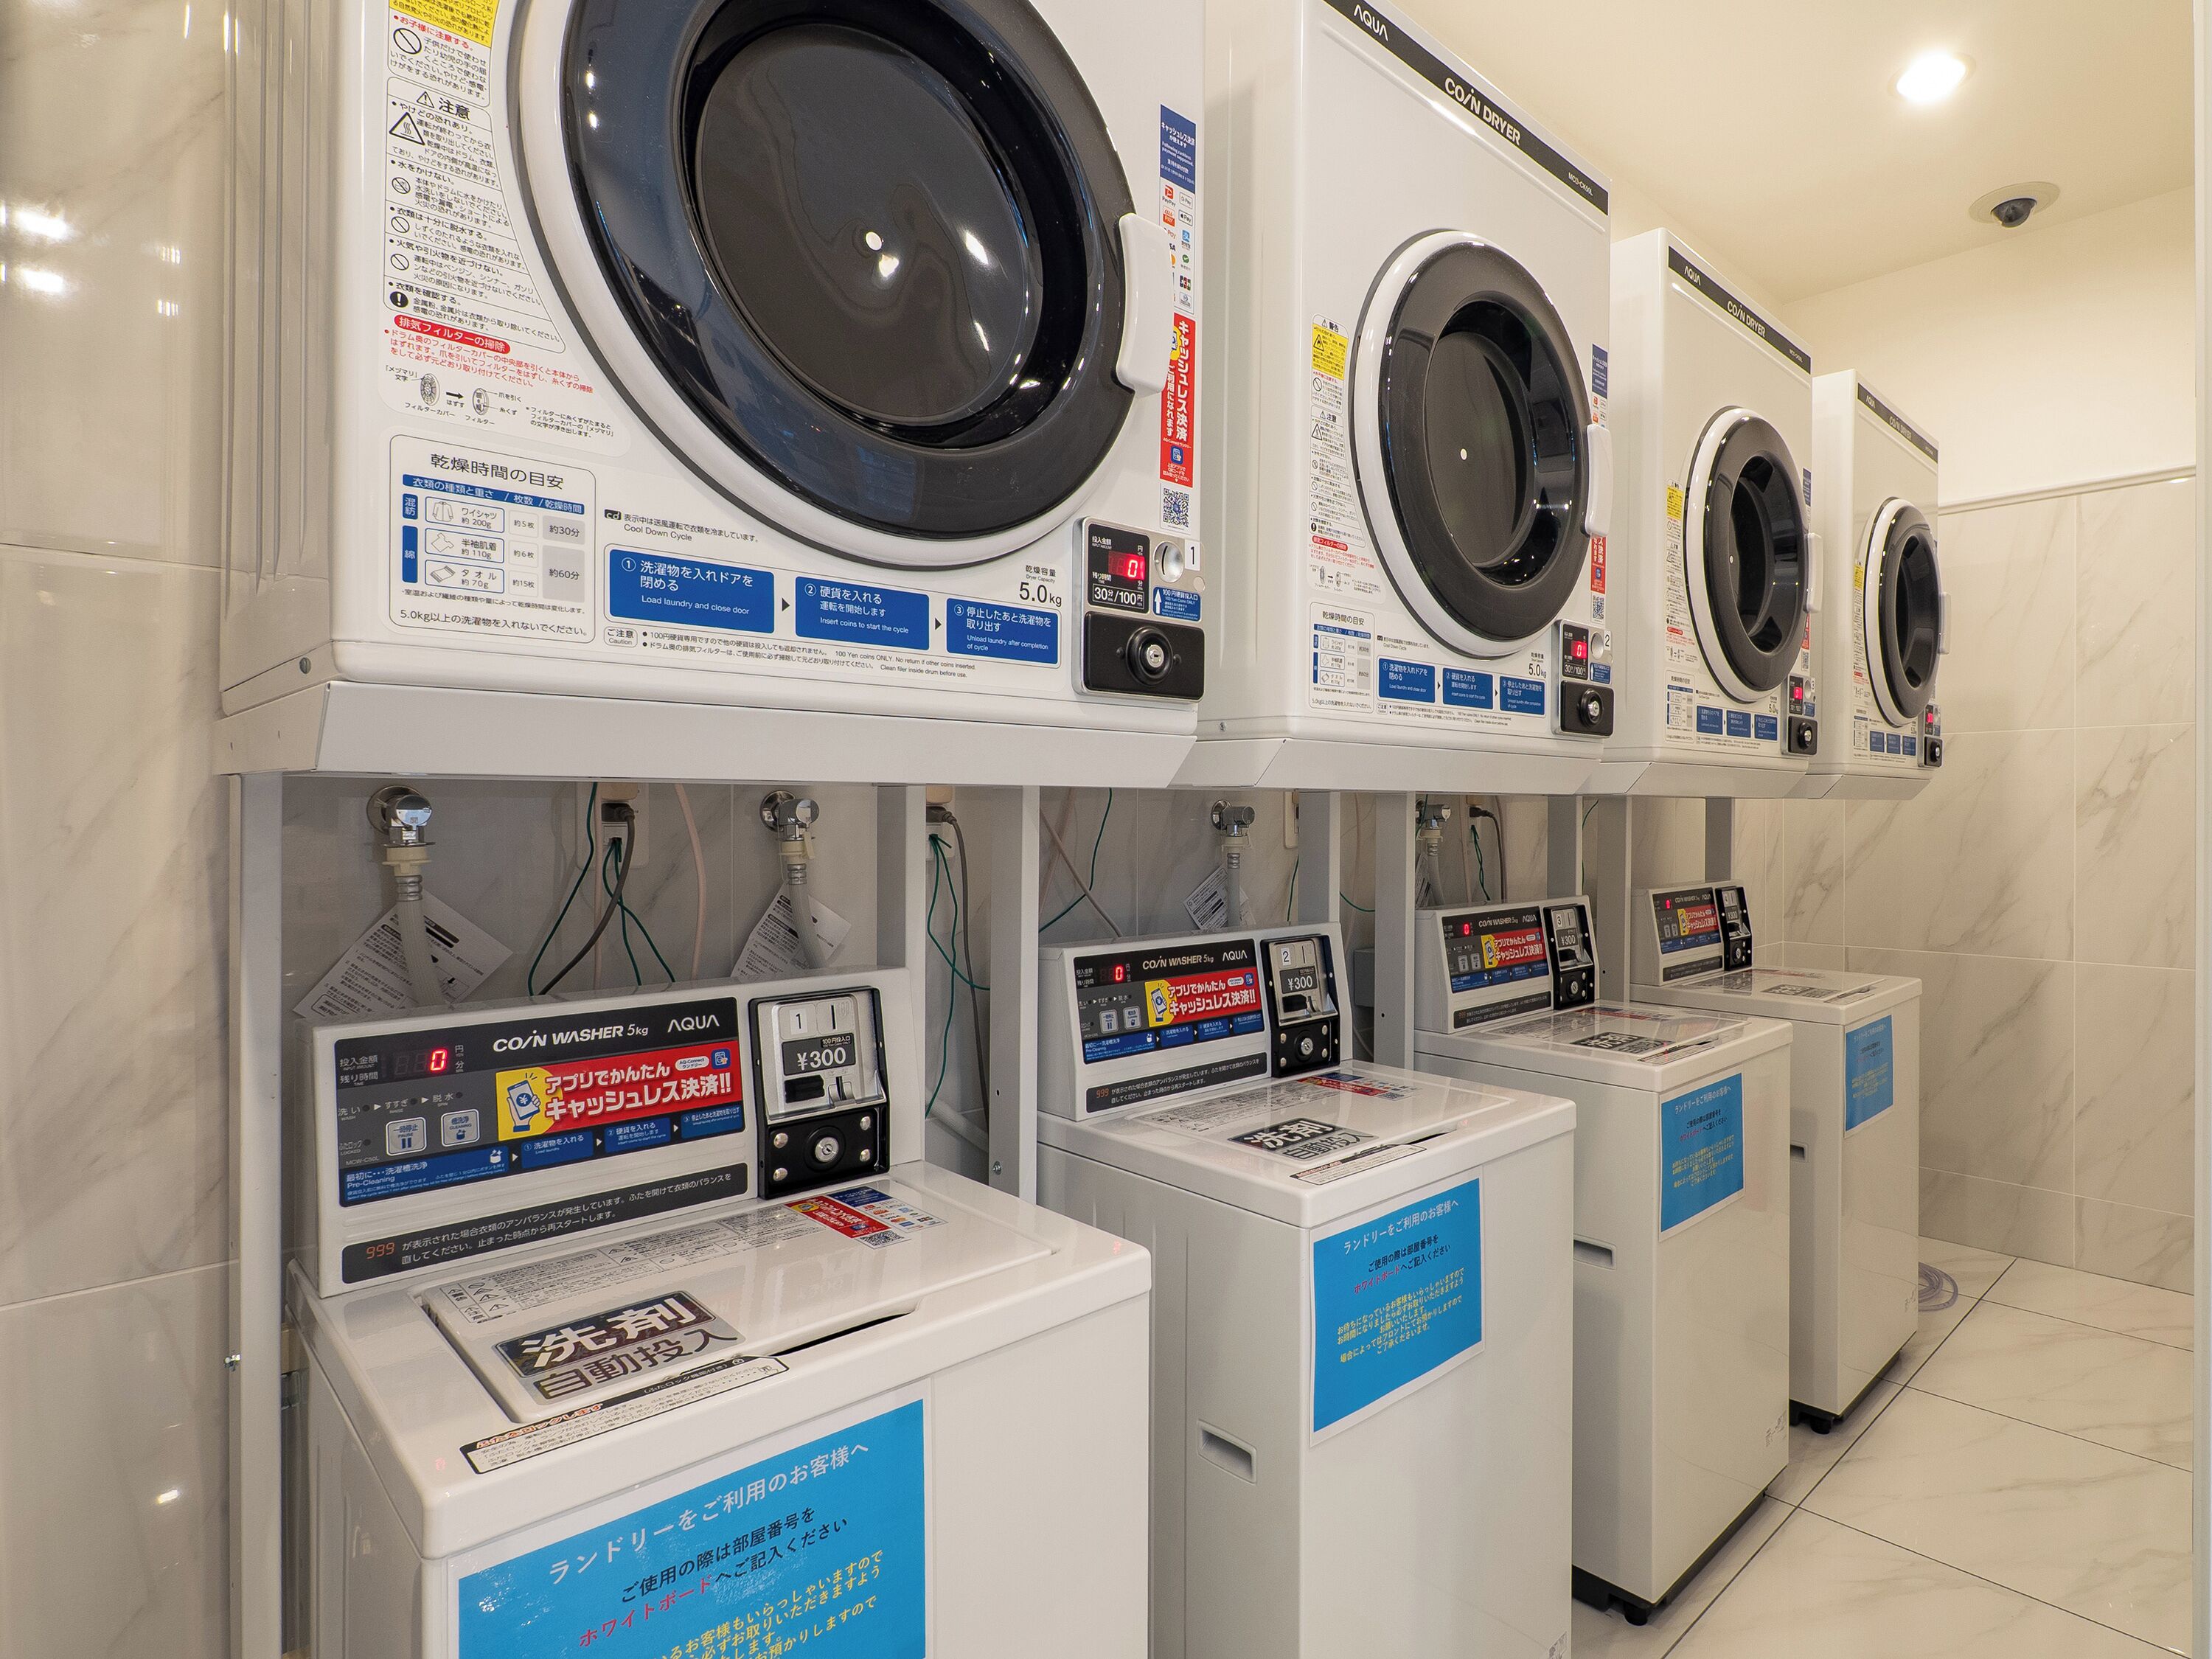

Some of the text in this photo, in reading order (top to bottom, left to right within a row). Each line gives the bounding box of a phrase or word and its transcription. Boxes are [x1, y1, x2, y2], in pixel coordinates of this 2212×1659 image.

[1354, 4, 1388, 41] AQUA
[400, 16, 473, 51] お子様に注意する。
[400, 102, 472, 134] やけどの恐れあり。
[439, 97, 470, 120] 注意
[1483, 105, 1521, 146] DRYER
[397, 161, 454, 184] 水をかけない。
[397, 206, 487, 240] 衣類は十分に脱水する。
[1684, 265, 1701, 285] AQUA
[396, 282, 462, 306] 衣類を確認する。
[398, 317, 507, 352] 排気フィルターの掃除
[1746, 317, 1766, 338] DRYER
[431, 453, 563, 490] 乾燥時間の目安
[624, 524, 692, 541] Cool Down Cycle
[640, 560, 754, 587] 洗濯物を入れドアを
[1025, 565, 1057, 577] 乾燥容量
[1128, 560, 1138, 578] 0
[640, 576, 679, 591] 閉める
[641, 595, 749, 614] Load laundry and close door
[820, 585, 883, 605] 硬貨を入れる
[820, 599, 886, 617] 運転を開始します
[967, 606, 1051, 627] 停止したあと洗濯物を
[1322, 611, 1364, 625] 乾燥時間の目安
[400, 609, 588, 636] 5.0kg以上の洗濯物を入れないでください。
[820, 617, 838, 625] Insert
[967, 618, 1002, 633] 取り出す
[607, 629, 634, 639] ご注意
[967, 635, 987, 643] Unload
[987, 637, 1007, 646] laundry
[1522, 914, 1537, 923] AQUA
[1561, 934, 1576, 946] ¥300
[1169, 955, 1203, 967] WASHER
[1222, 950, 1248, 962] AQUA
[1282, 950, 1290, 963] 2
[1116, 967, 1122, 981] 0
[1287, 975, 1313, 991] ¥300
[1168, 980, 1225, 998] アプリでかんたん
[667, 1015, 720, 1033] AQUA
[552, 1025, 624, 1045] WASHER
[627, 1024, 649, 1037] 5kg
[455, 1045, 464, 1053] 円
[797, 1047, 846, 1071] ¥300
[340, 1054, 378, 1065] 投入金額
[430, 1050, 446, 1071] 0
[455, 1060, 465, 1069] 分
[340, 1071, 378, 1084] 残り時間
[546, 1062, 670, 1093] アプリでかんたん
[385, 1099, 408, 1109] すすぎ
[546, 1072, 731, 1121] キャッシュレス決済!!
[616, 1122, 655, 1135] 硬貨を入れる
[1243, 1120, 1334, 1149] 洗剤
[534, 1134, 585, 1150] 洗濯物を入れる
[1283, 1132, 1374, 1159] 自動投入
[347, 1175, 395, 1189] Pre-Cleaning
[1343, 1199, 1458, 1256] ランドリーをご利用のお客様へ
[401, 1211, 616, 1265] 直してください。止まった時点から再スタートします。
[366, 1242, 395, 1260] 999
[1368, 1234, 1439, 1273] ご使用の際は部屋番号を
[1354, 1245, 1451, 1294] ホワイトボードへご記入ください
[521, 1295, 698, 1368] 洗剤
[532, 1326, 738, 1399] 自動投入
[549, 1444, 869, 1585] ランドリーをご利用のお客様へ
[621, 1506, 816, 1604] ご使用の際は部屋番号を
[578, 1517, 849, 1649] ホワイトボードへご記入ください
[654, 1550, 883, 1659] るお客様もいらっしゃいますので
